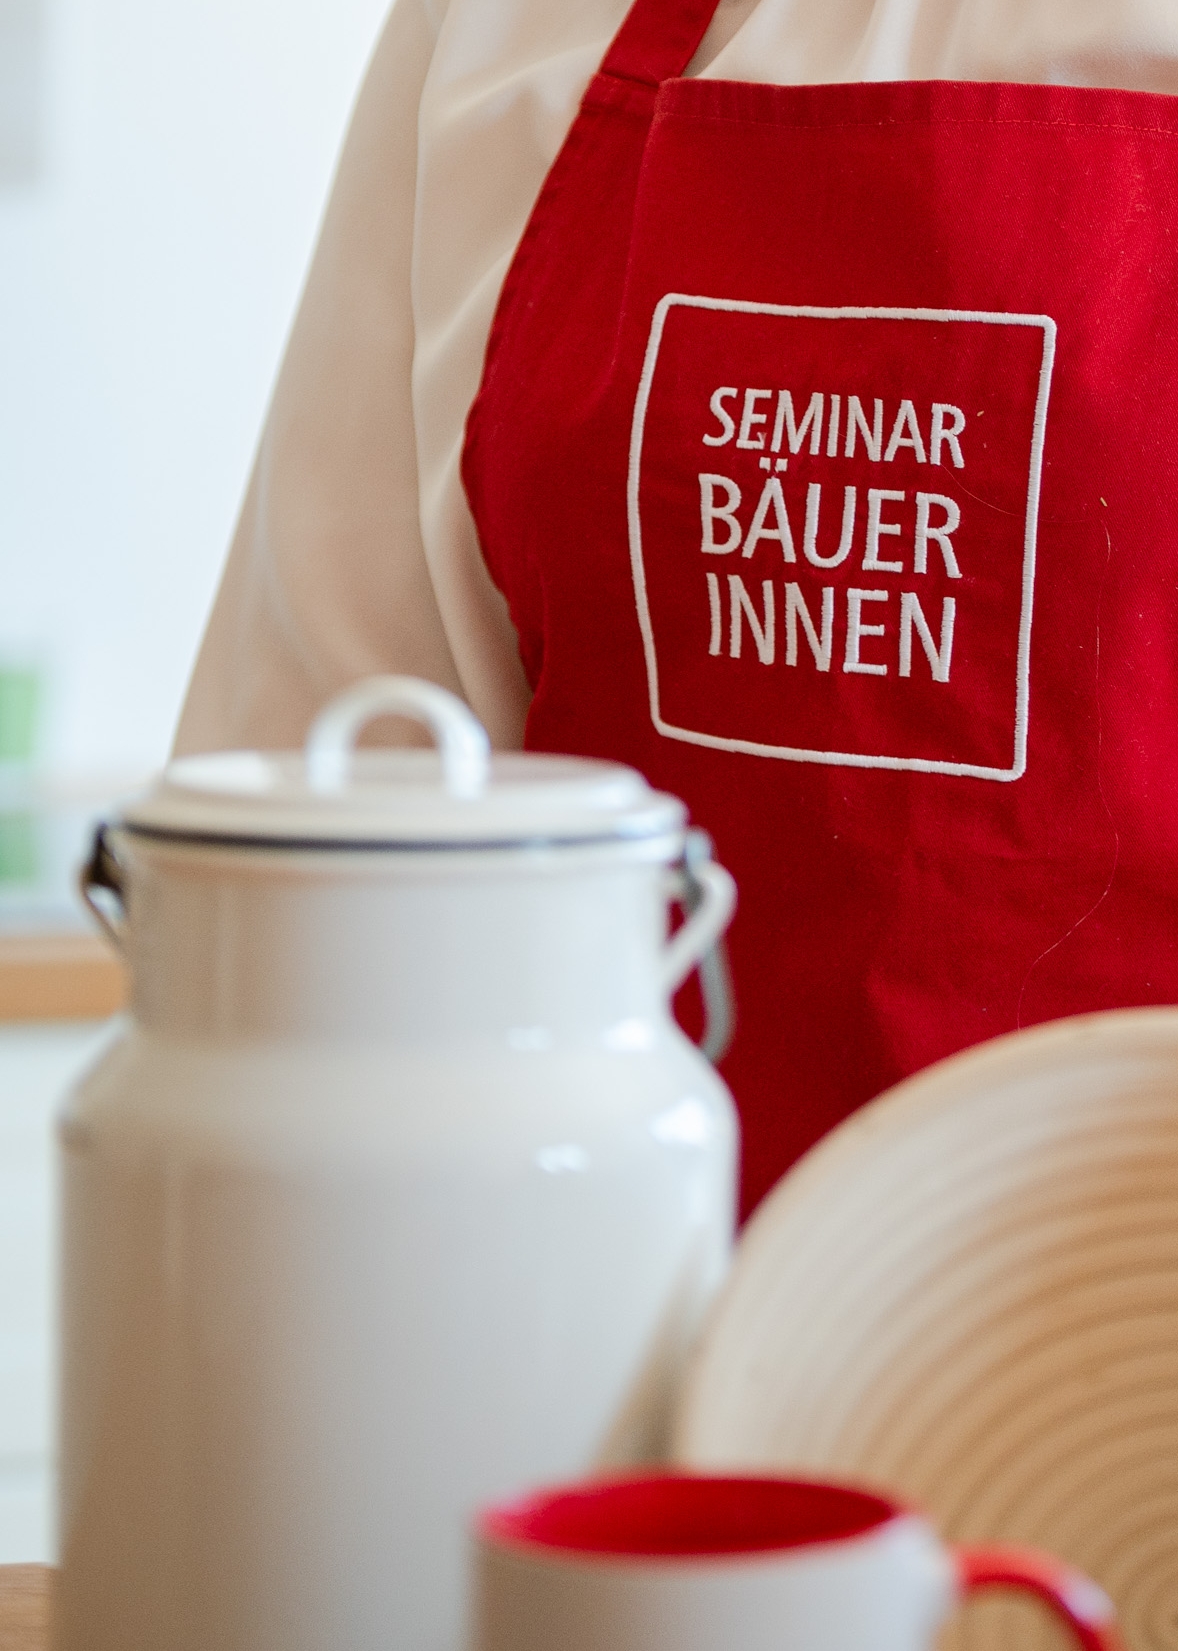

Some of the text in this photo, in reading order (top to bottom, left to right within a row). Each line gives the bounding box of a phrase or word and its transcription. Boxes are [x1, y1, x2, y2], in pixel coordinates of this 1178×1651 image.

[701, 386, 967, 469] SEMINAR
[698, 456, 963, 579] BÄUER
[706, 572, 956, 683] INNEN
